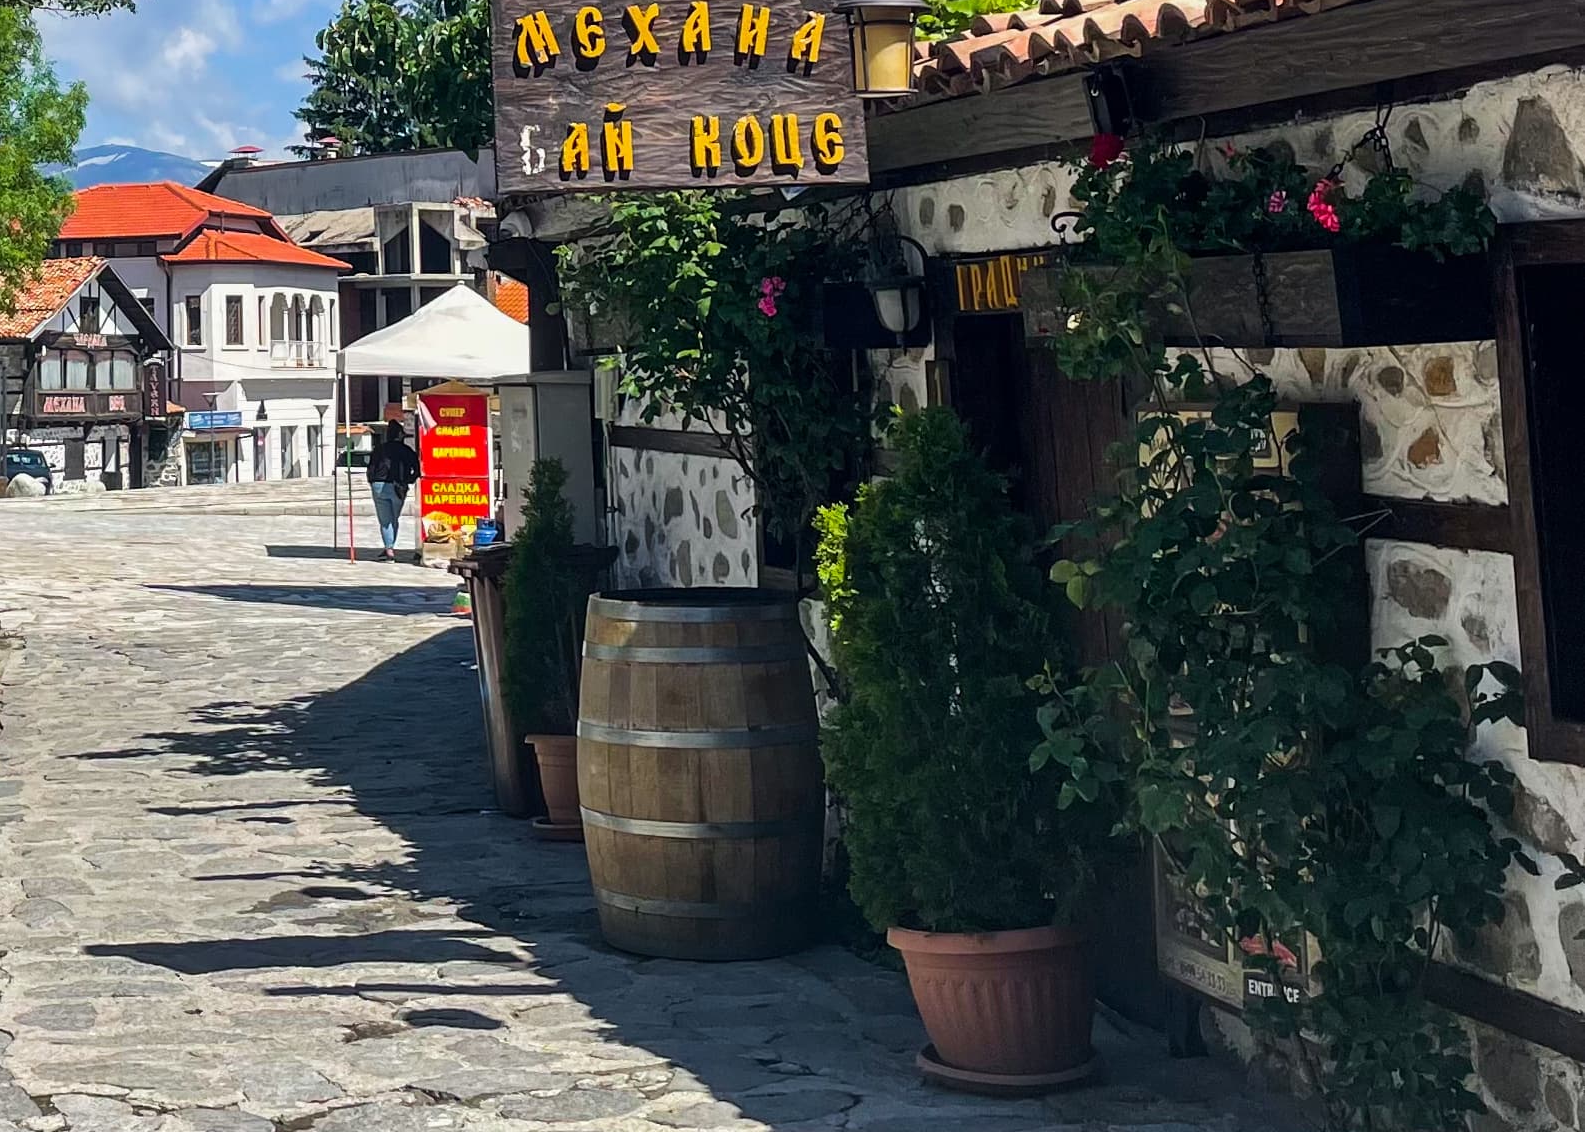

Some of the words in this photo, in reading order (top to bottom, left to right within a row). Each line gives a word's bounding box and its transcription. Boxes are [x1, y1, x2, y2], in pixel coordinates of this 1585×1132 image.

[516, 0, 826, 67] МЕХАНА
[691, 112, 845, 169] КОЦЕ
[43, 396, 85, 412] МЕХАНА
[432, 483, 479, 493] СЛАДКА
[425, 495, 488, 505] ЦАРЕВИЦА
